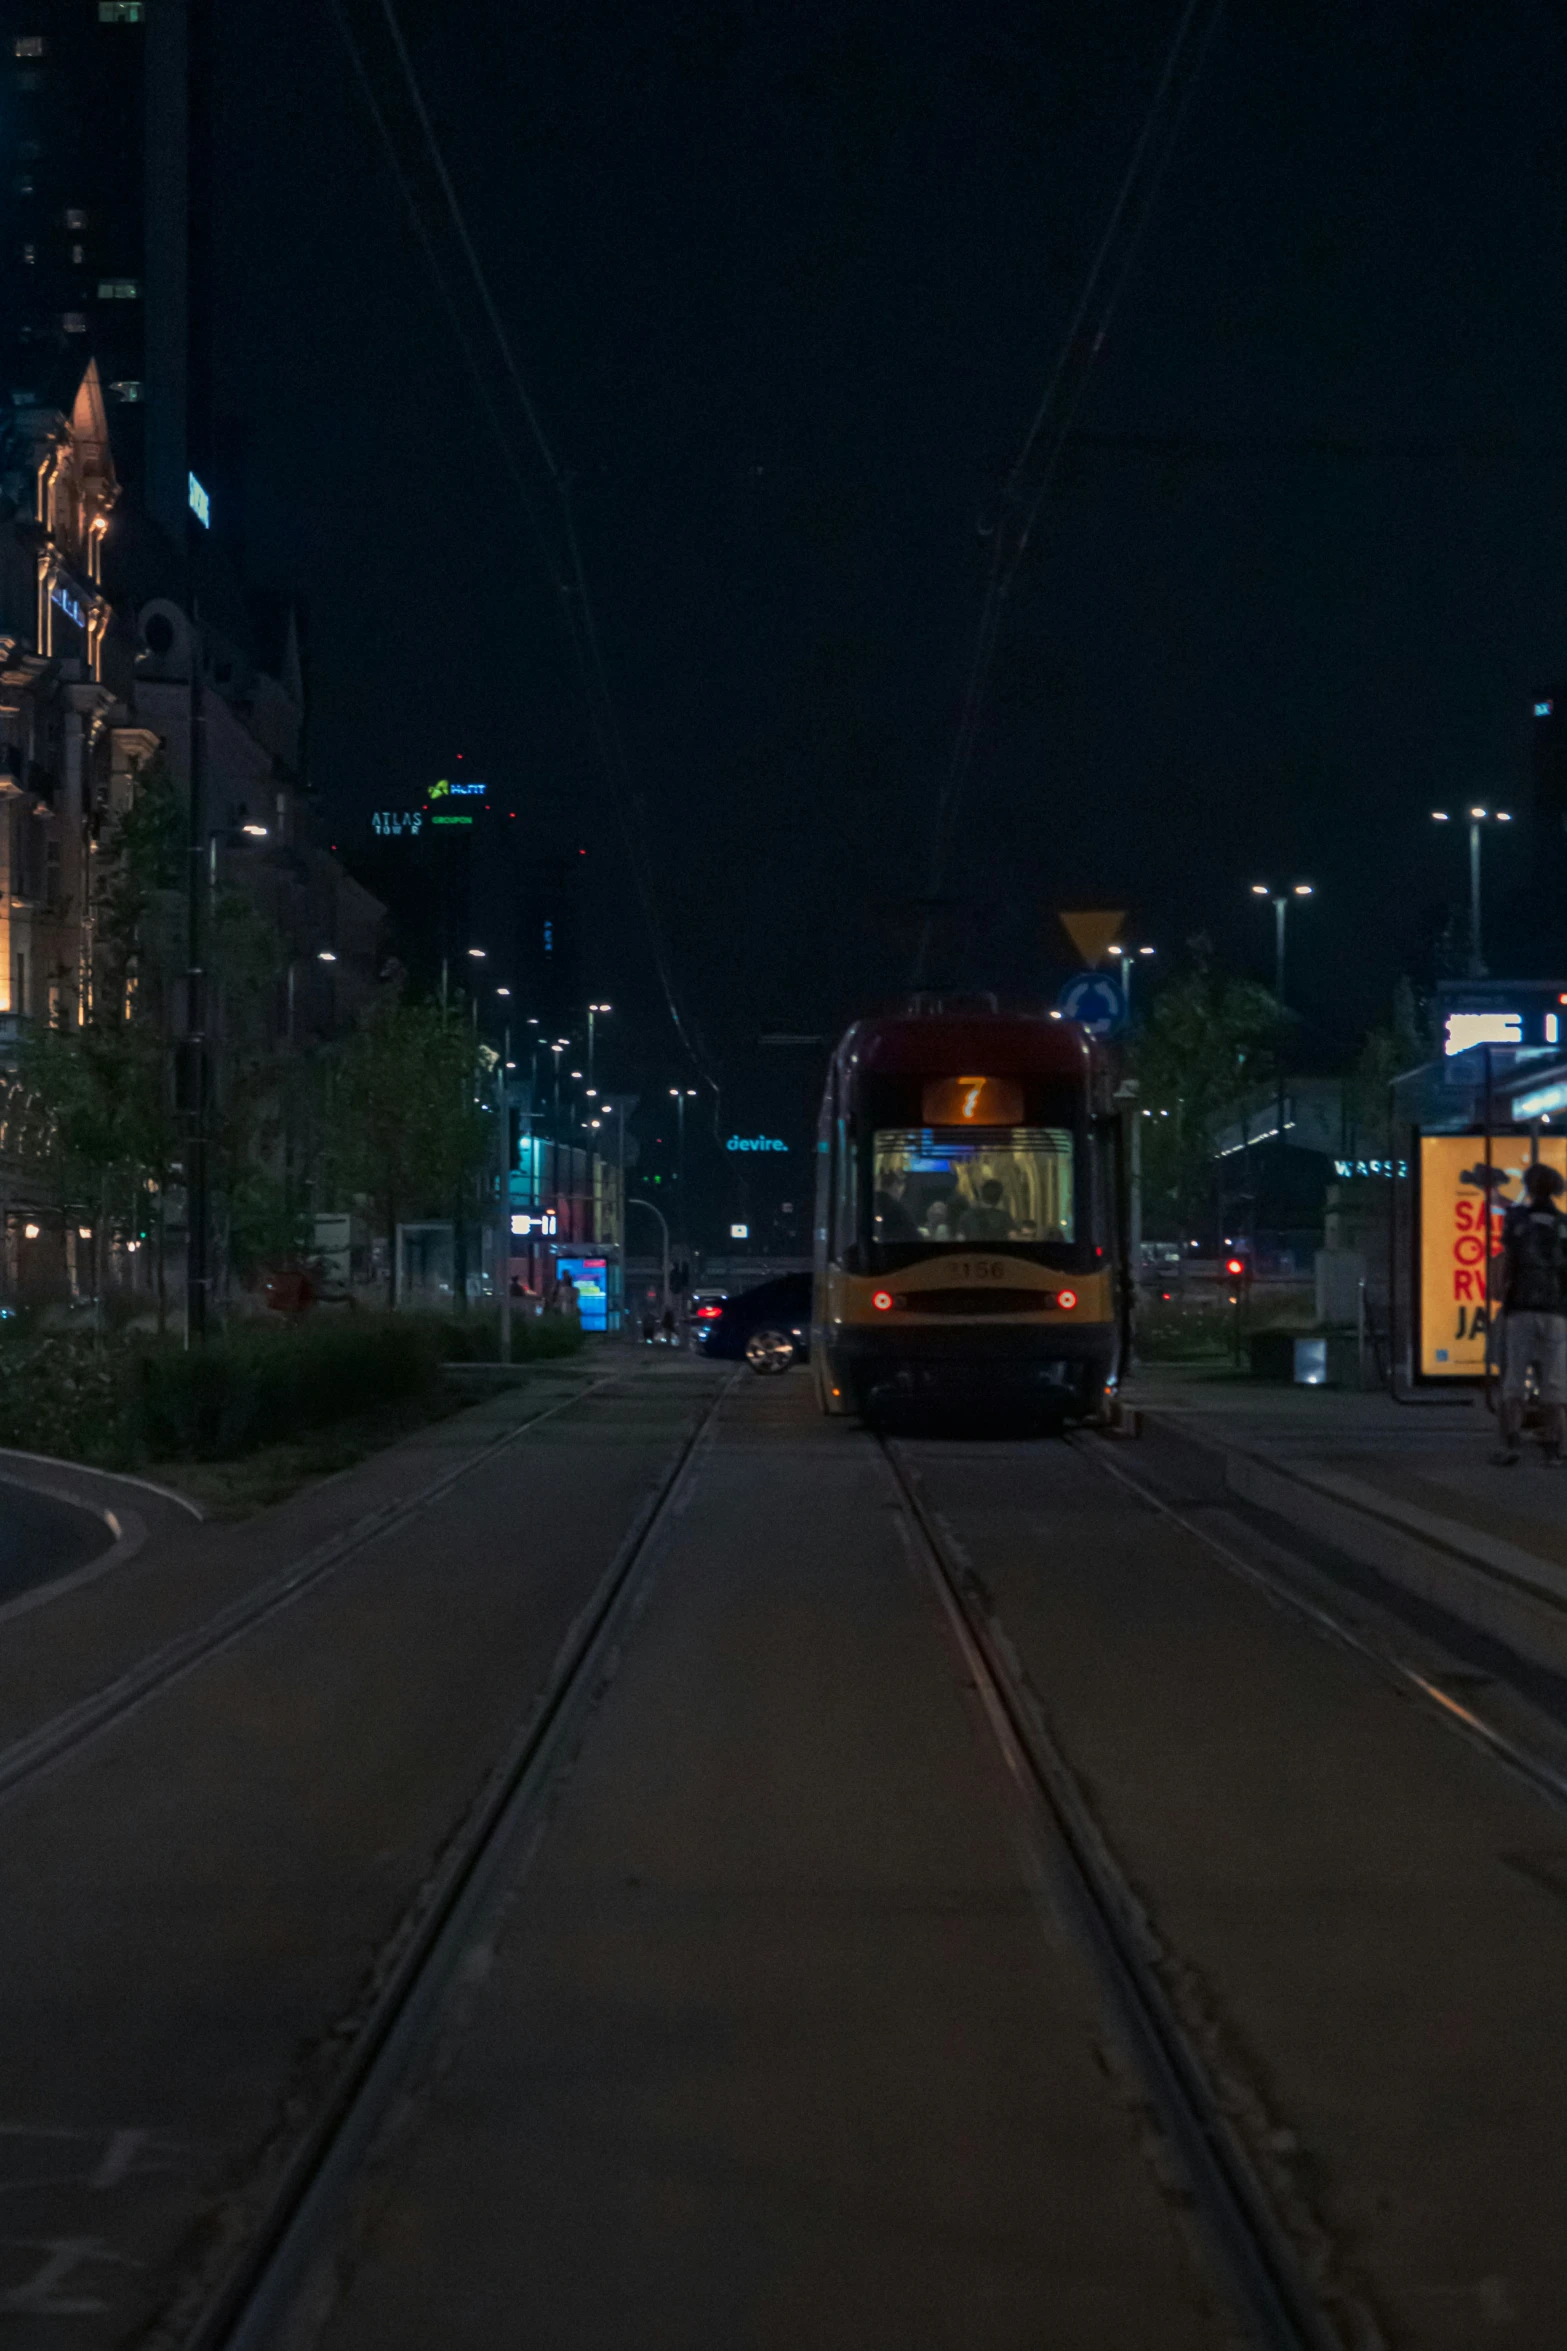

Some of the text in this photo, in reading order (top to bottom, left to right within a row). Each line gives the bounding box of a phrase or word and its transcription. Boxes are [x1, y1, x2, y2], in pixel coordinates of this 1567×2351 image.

[372, 812, 422, 826] ATLAS
[375, 826, 419, 836] TOWR
[957, 1075, 988, 1119] 7
